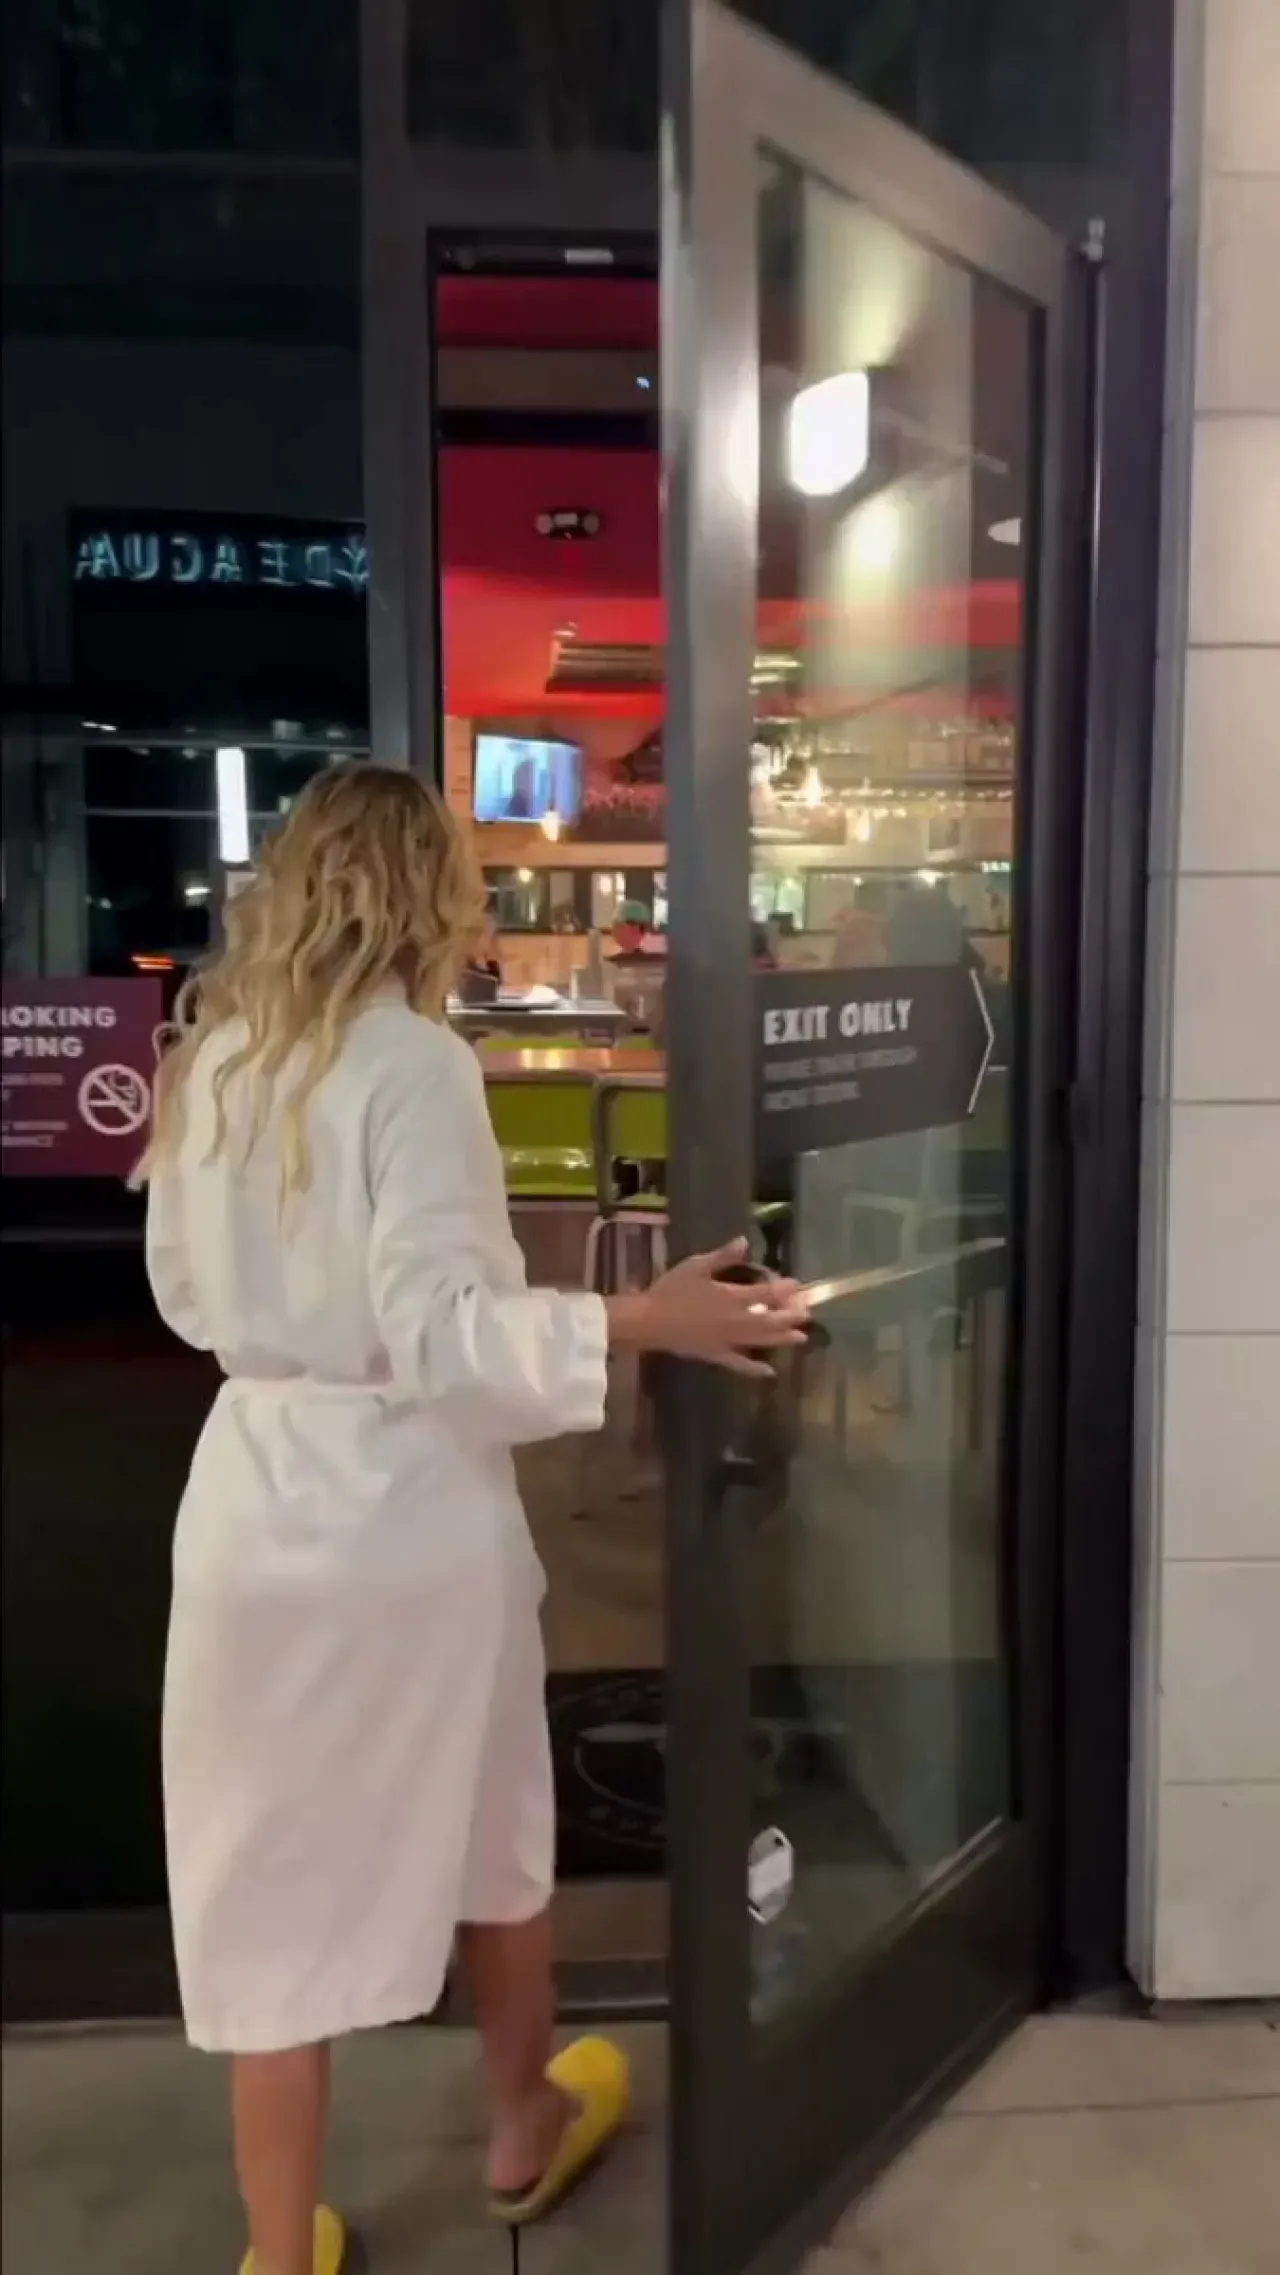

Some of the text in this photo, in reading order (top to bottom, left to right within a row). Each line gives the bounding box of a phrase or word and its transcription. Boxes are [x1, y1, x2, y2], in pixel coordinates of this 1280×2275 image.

[2, 1006, 117, 1028] OKING
[763, 998, 913, 1045] EXIT ONLY
